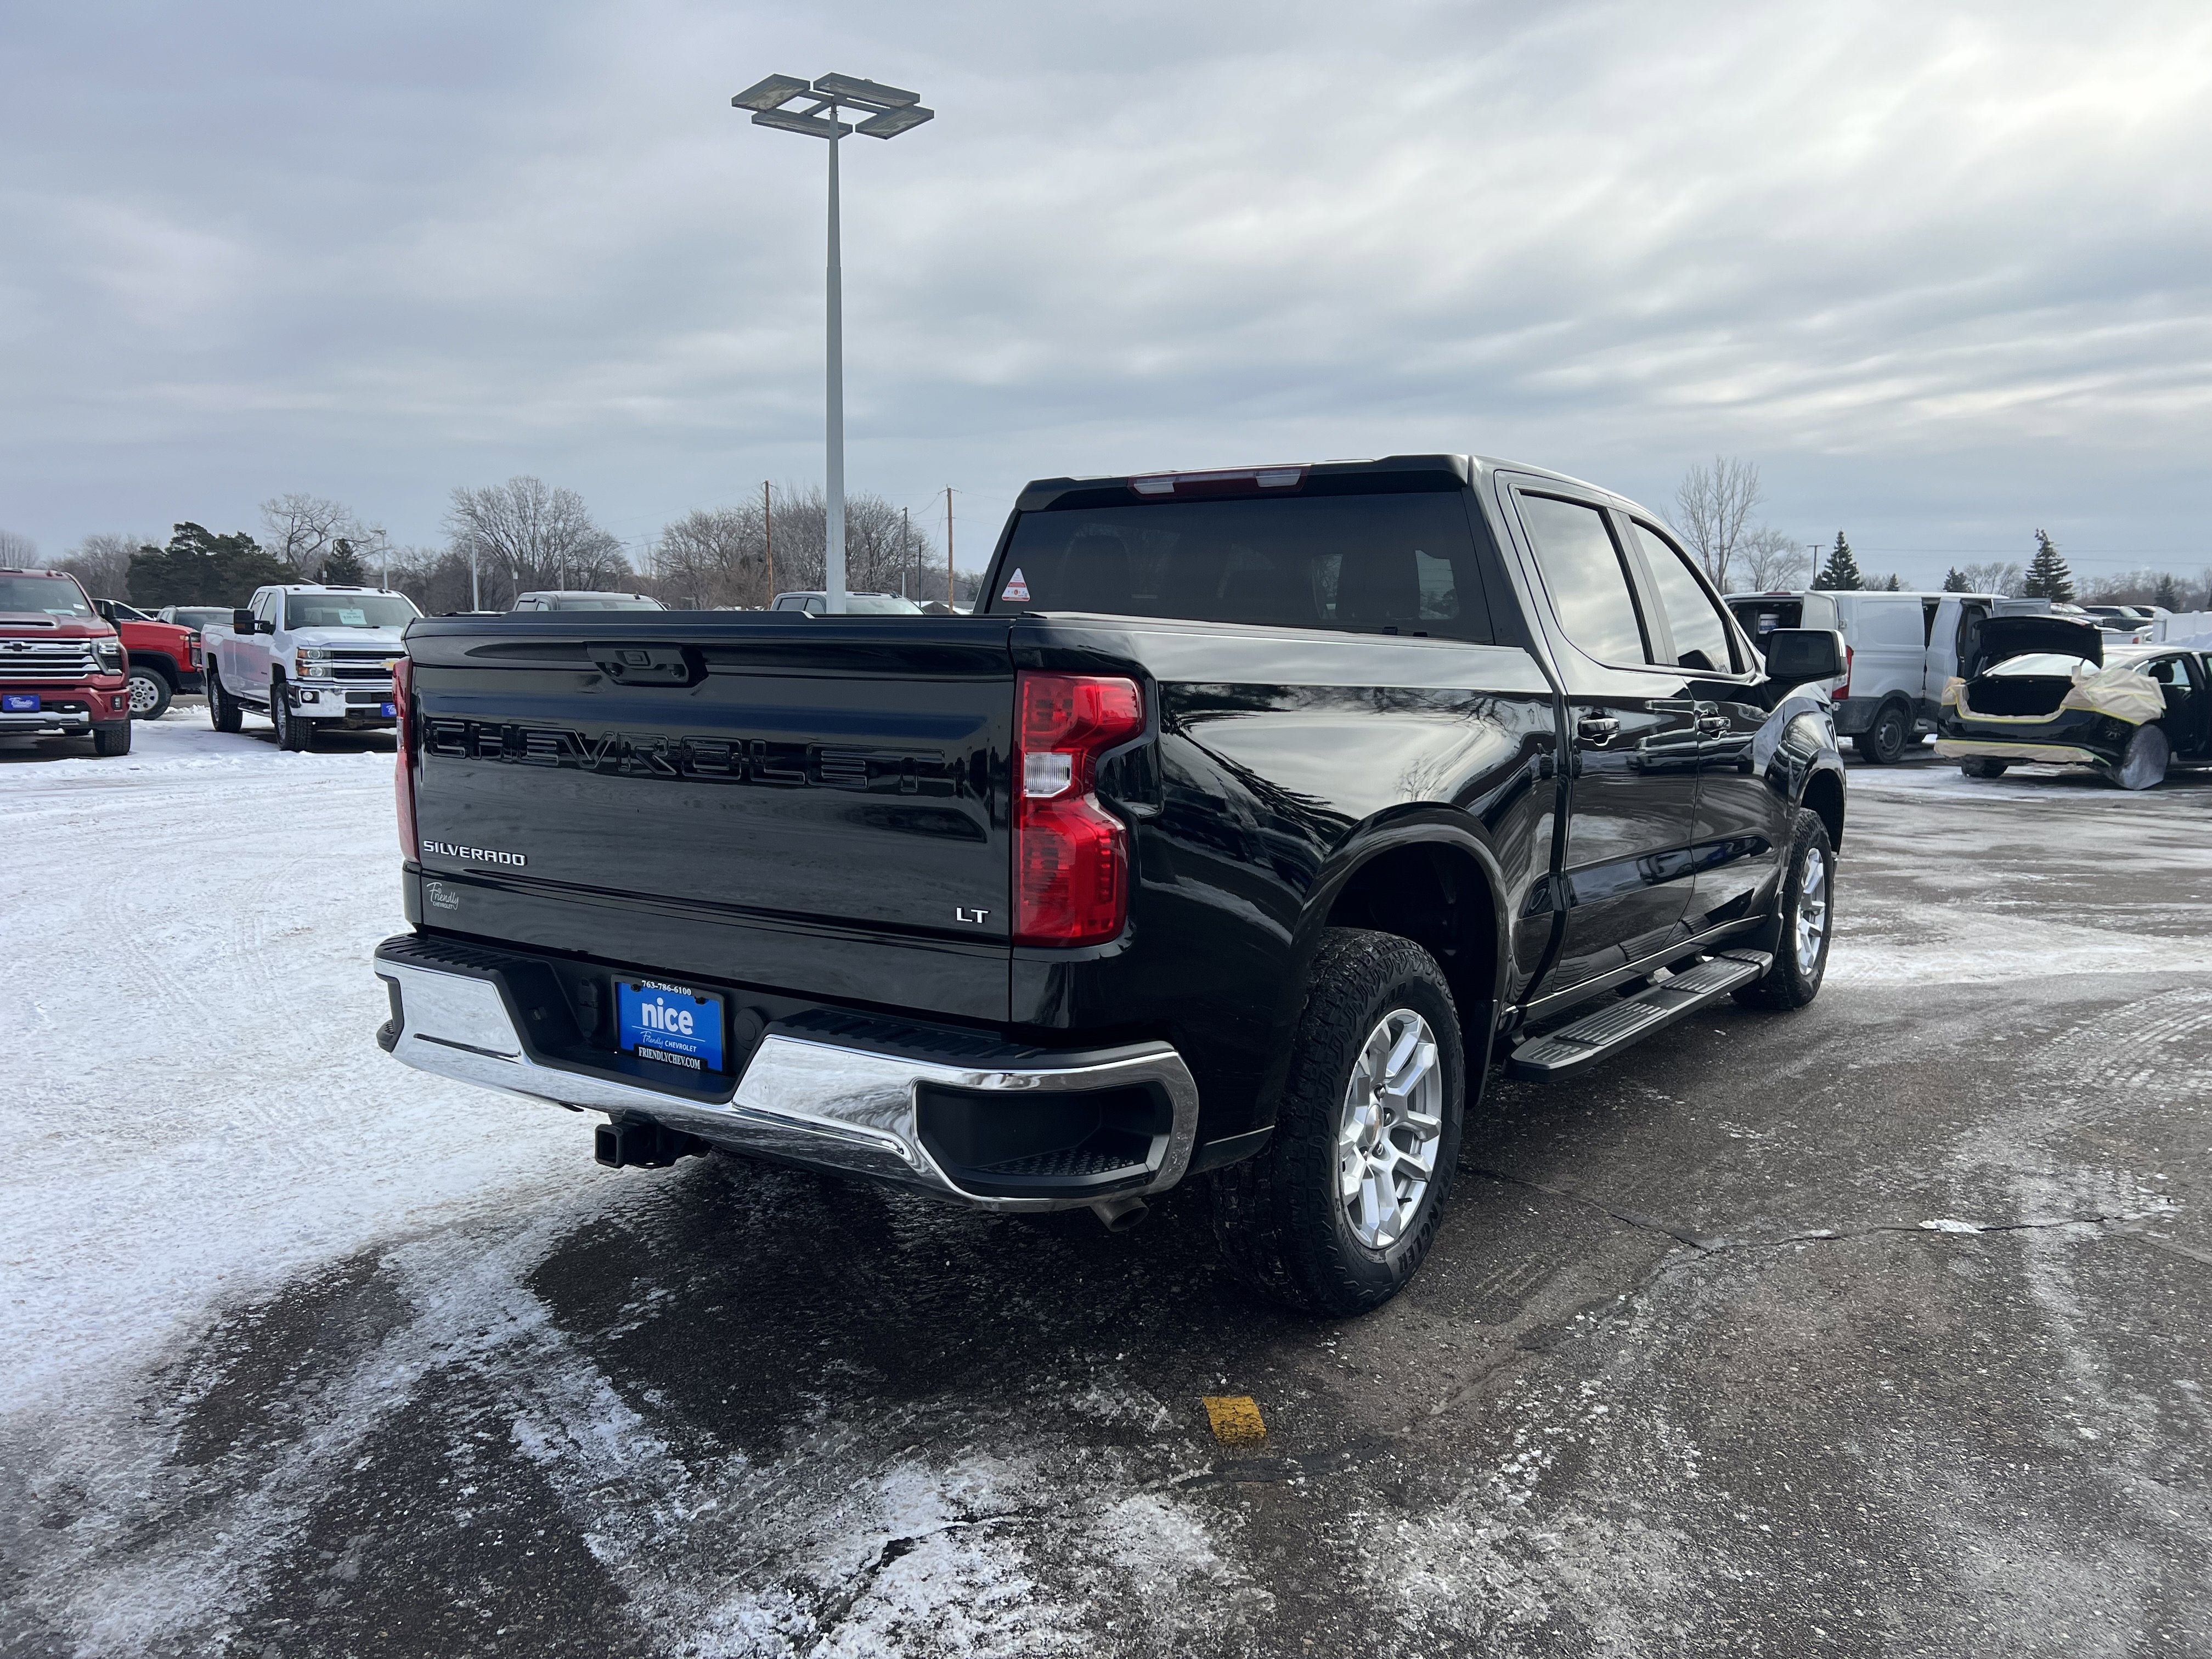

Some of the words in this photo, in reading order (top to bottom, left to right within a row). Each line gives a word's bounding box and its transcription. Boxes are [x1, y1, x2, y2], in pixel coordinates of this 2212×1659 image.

[431, 721, 945, 793] CHEVROLET
[424, 840, 526, 866] SILVERADO
[427, 882, 459, 910] Friendly
[956, 907, 989, 923] LT
[641, 980, 692, 996] 763-786-6100
[641, 997, 693, 1035] nice
[640, 1031, 664, 1048] Friendly
[664, 1040, 697, 1052] CHEVROLET
[638, 1046, 701, 1070] FRIENDLYCHEV.COM
